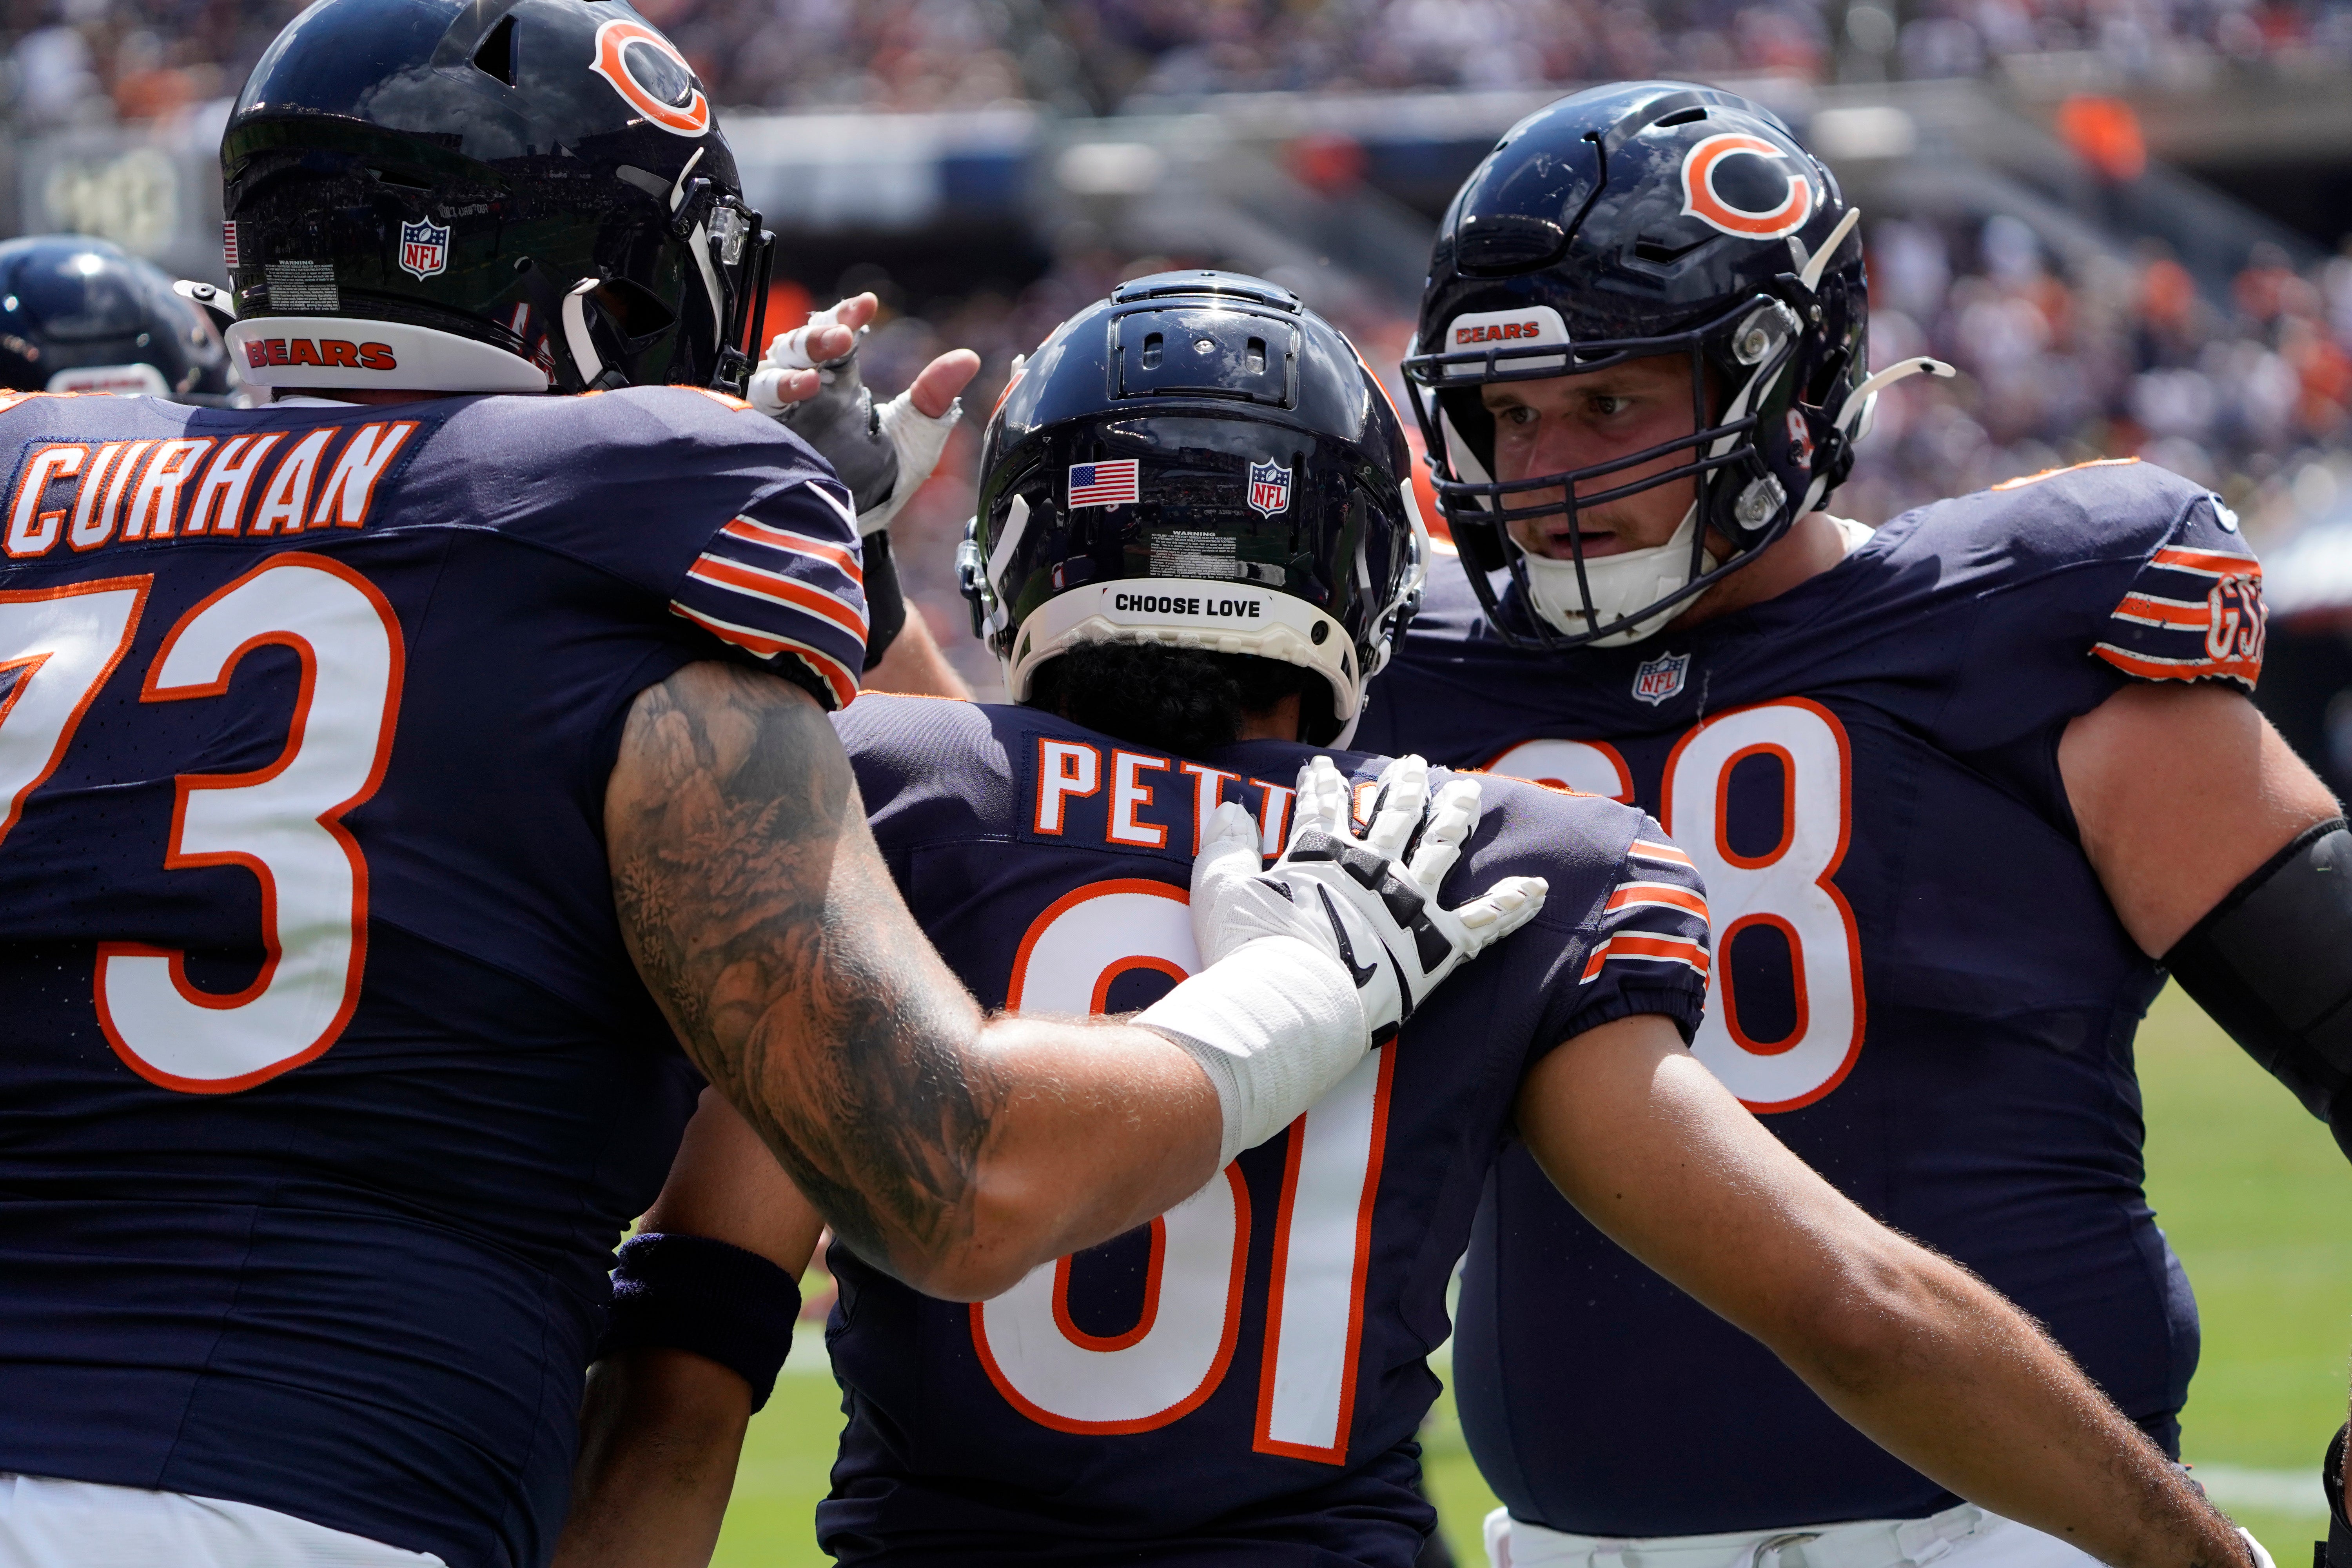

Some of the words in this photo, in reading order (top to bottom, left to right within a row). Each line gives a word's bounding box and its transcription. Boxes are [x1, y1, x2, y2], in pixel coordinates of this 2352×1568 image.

[405, 243, 440, 270] NFL
[1456, 321, 1539, 344] BEARS
[245, 338, 397, 370] BEARS
[2, 421, 421, 559] CURHAN
[1254, 483, 1285, 509] NFL
[1116, 594, 1200, 615] CHOOSE
[1207, 599, 1260, 617] LOVE
[2205, 572, 2269, 662] GS
[1639, 670, 1677, 695] NFL
[1034, 737, 1378, 859] PETT
[0, 551, 405, 1094] 73
[1482, 696, 1867, 1114] 8
